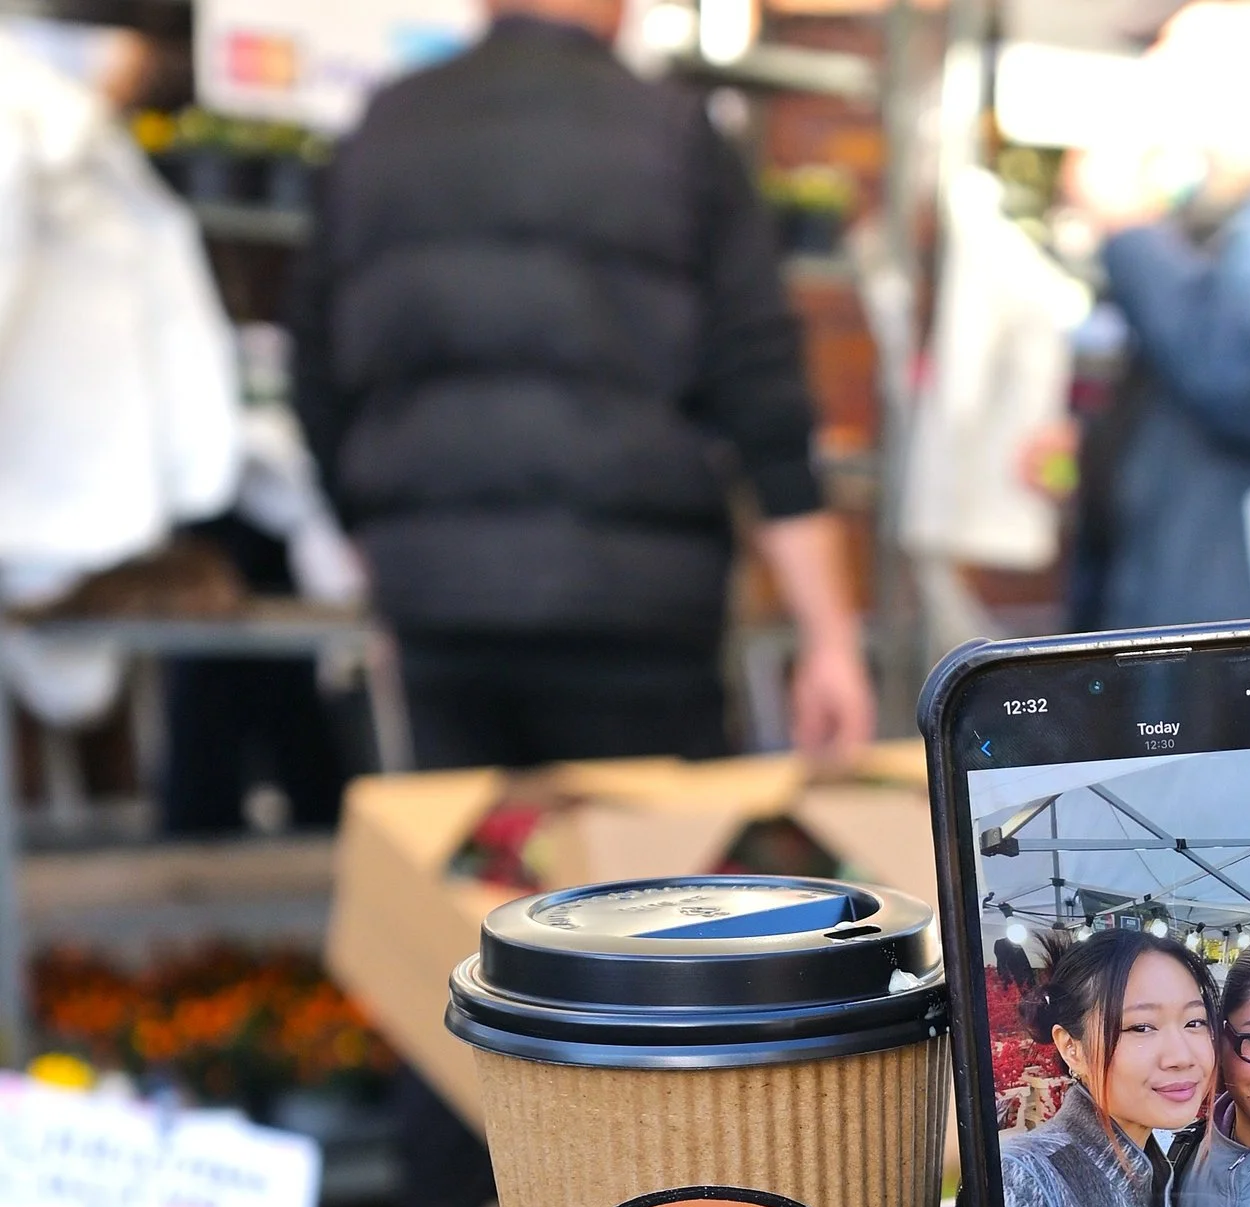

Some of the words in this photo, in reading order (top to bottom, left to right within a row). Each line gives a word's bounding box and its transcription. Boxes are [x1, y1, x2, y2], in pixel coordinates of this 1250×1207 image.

[1003, 698, 1048, 715] 12:32
[1137, 721, 1180, 736] Today
[1145, 739, 1175, 750] 12:30
